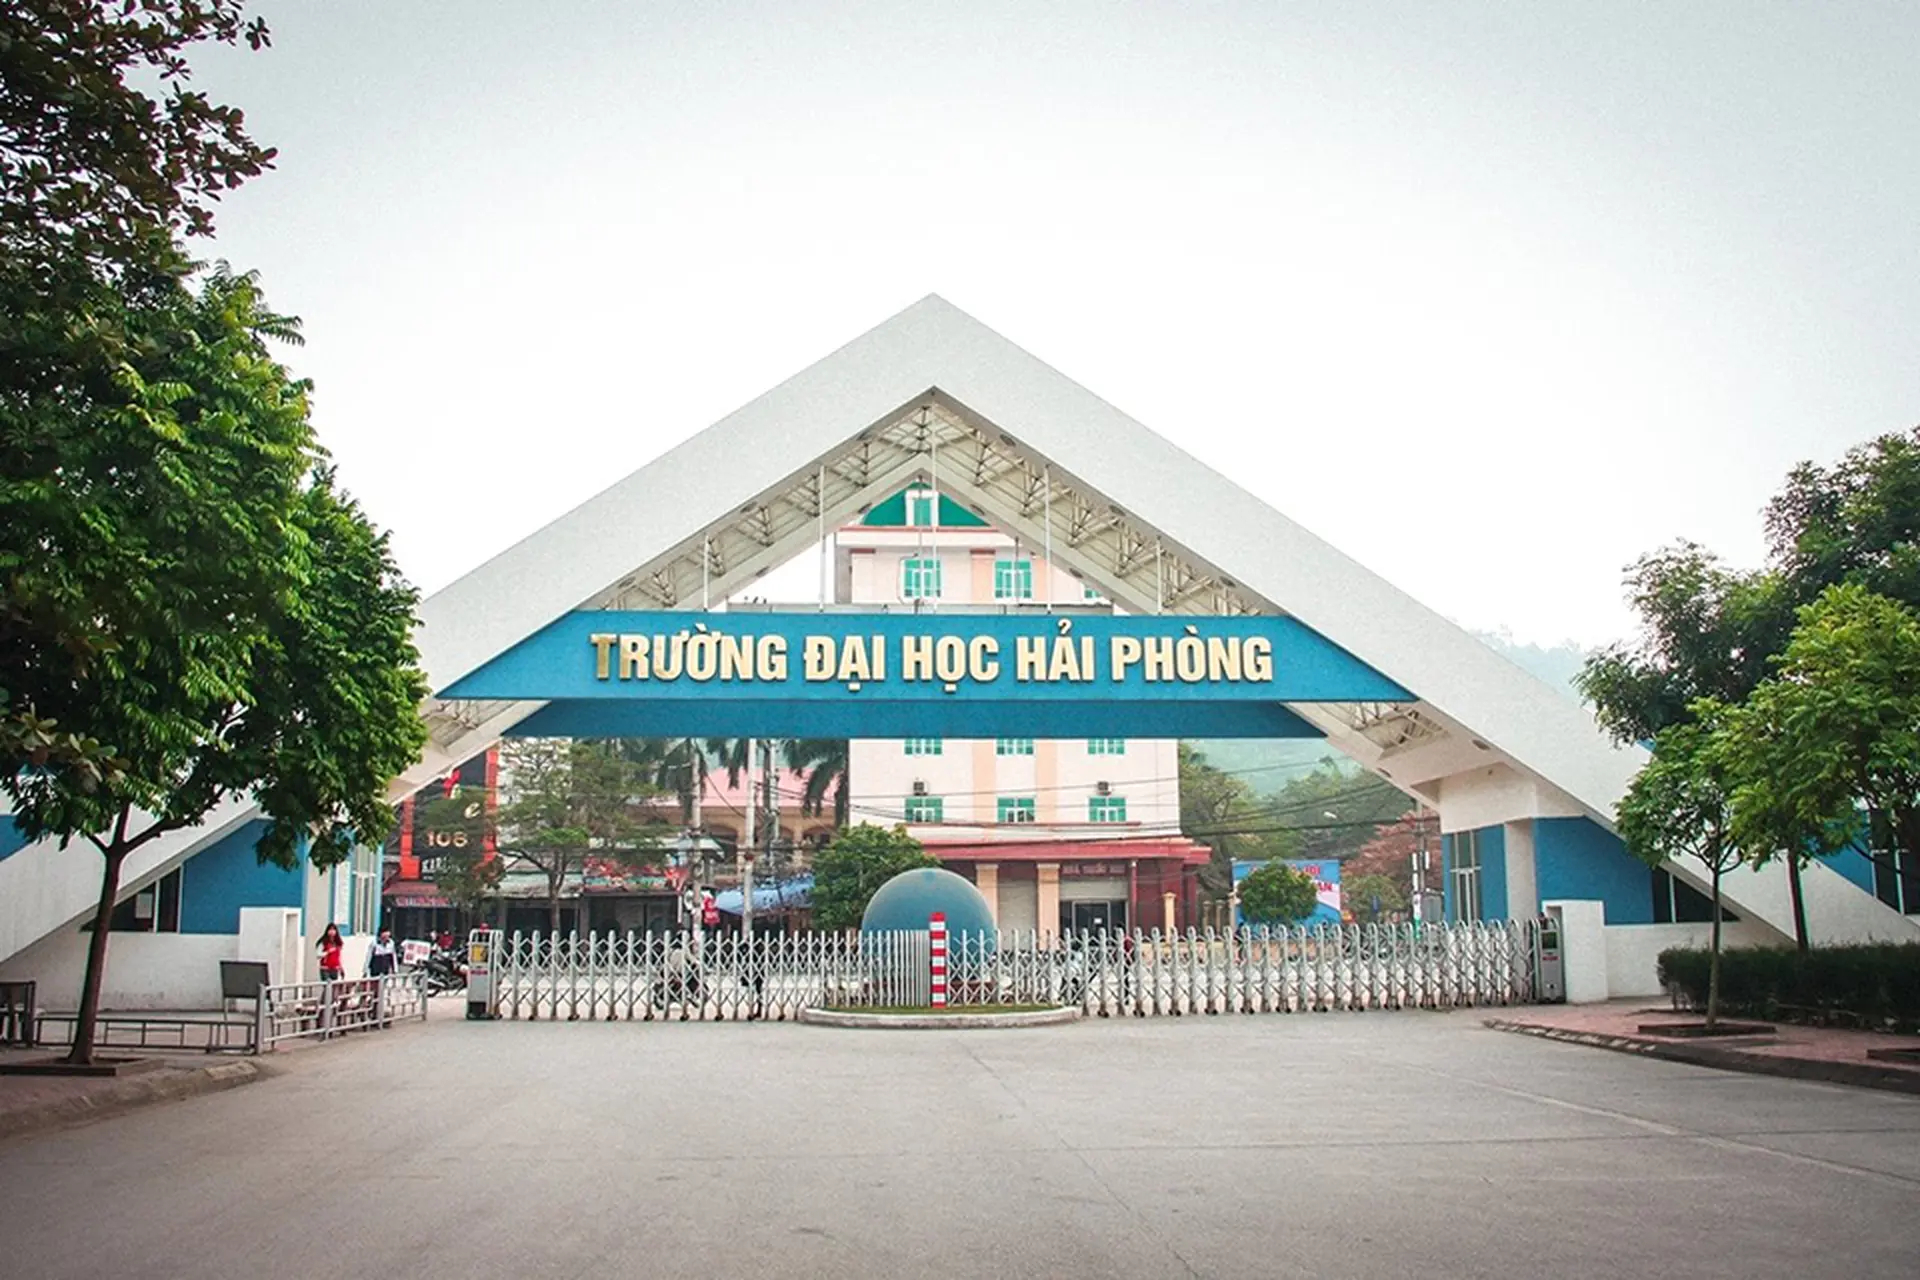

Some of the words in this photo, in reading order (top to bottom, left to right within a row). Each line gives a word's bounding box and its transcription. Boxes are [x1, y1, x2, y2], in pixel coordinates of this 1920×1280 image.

[590, 623, 788, 681] TRƯỜNG
[803, 635, 886, 691] ĐẠI
[902, 635, 999, 692] HỌC
[1016, 618, 1095, 681] HẢI
[1111, 625, 1273, 682] PHÒNG
